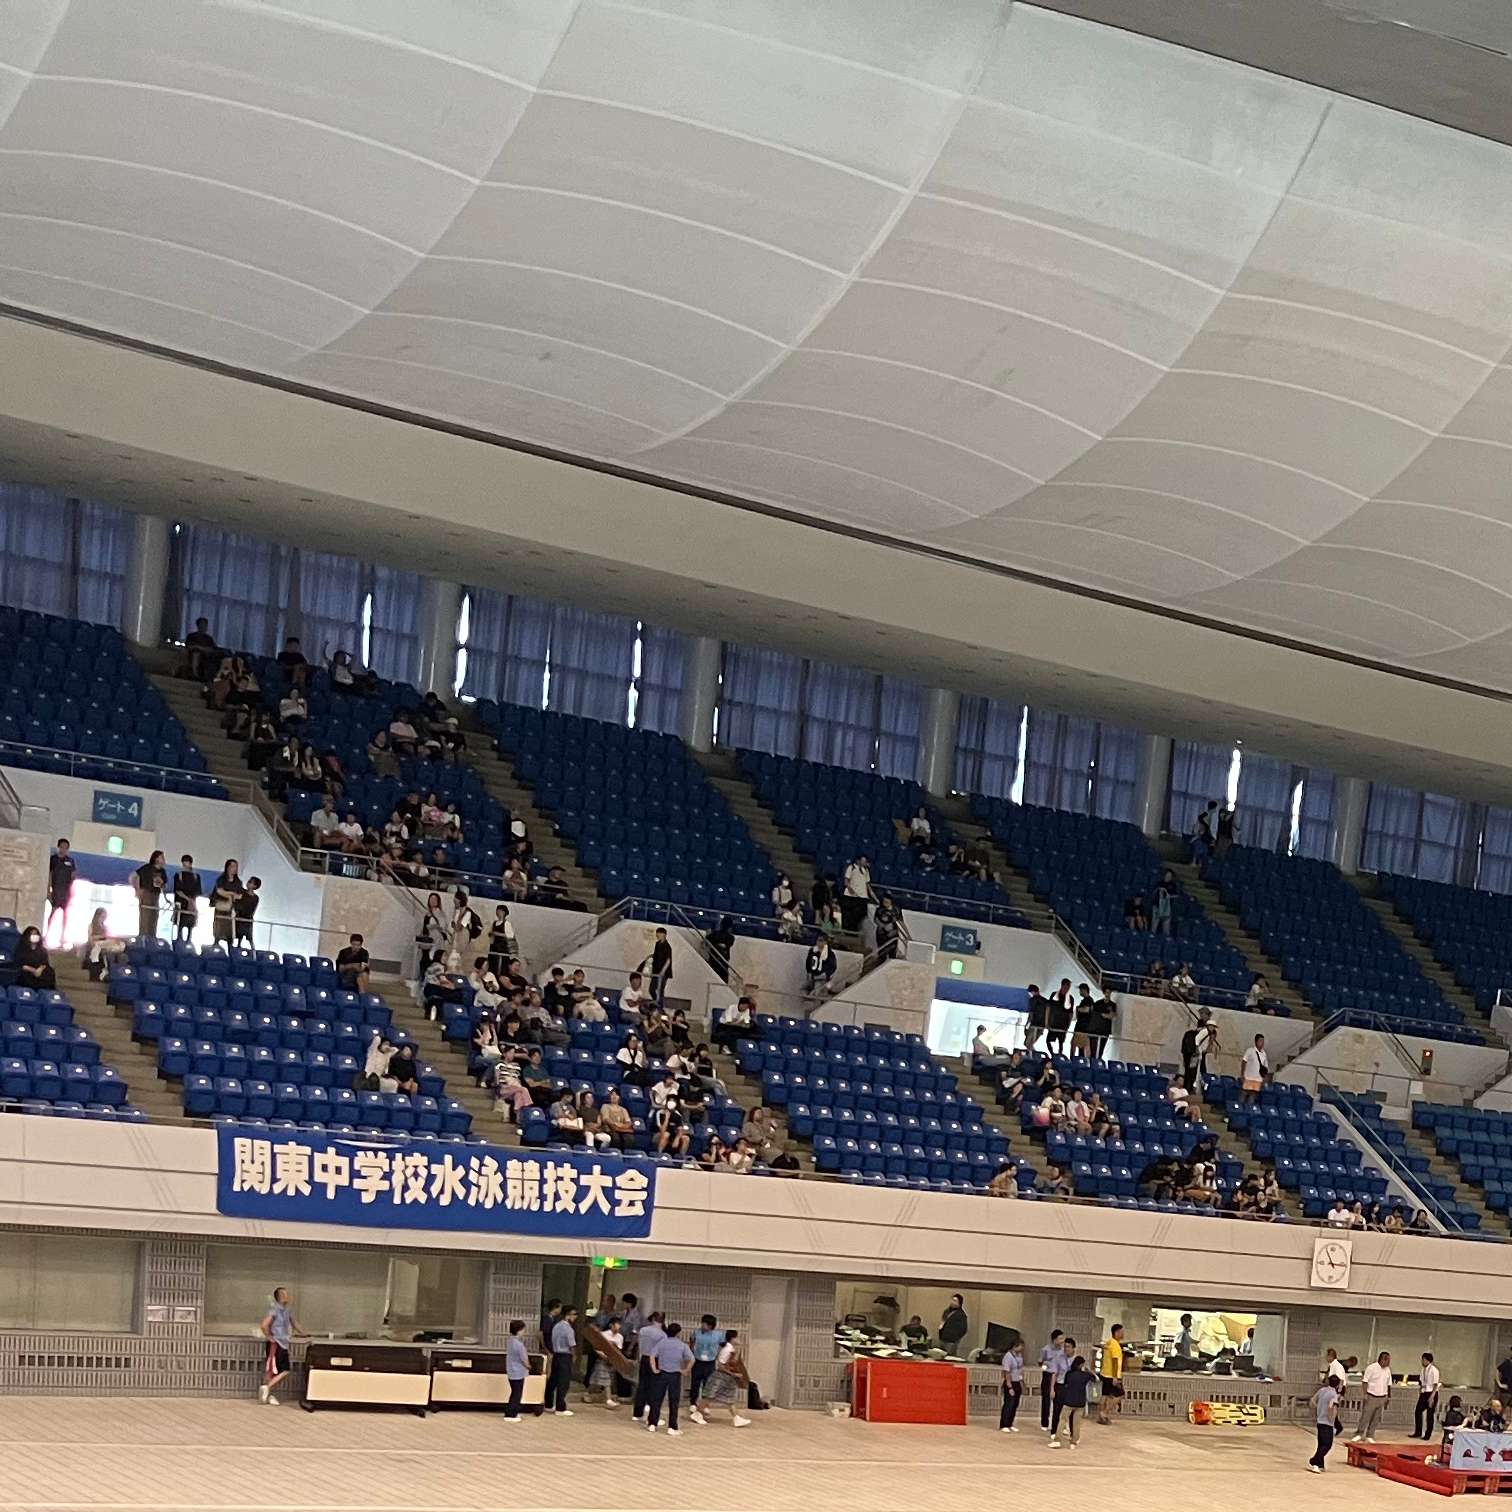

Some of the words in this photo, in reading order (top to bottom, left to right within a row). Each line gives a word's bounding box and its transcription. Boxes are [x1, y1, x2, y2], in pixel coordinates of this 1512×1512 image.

[232, 1136, 651, 1218] 関東中学校水泳競技大会
